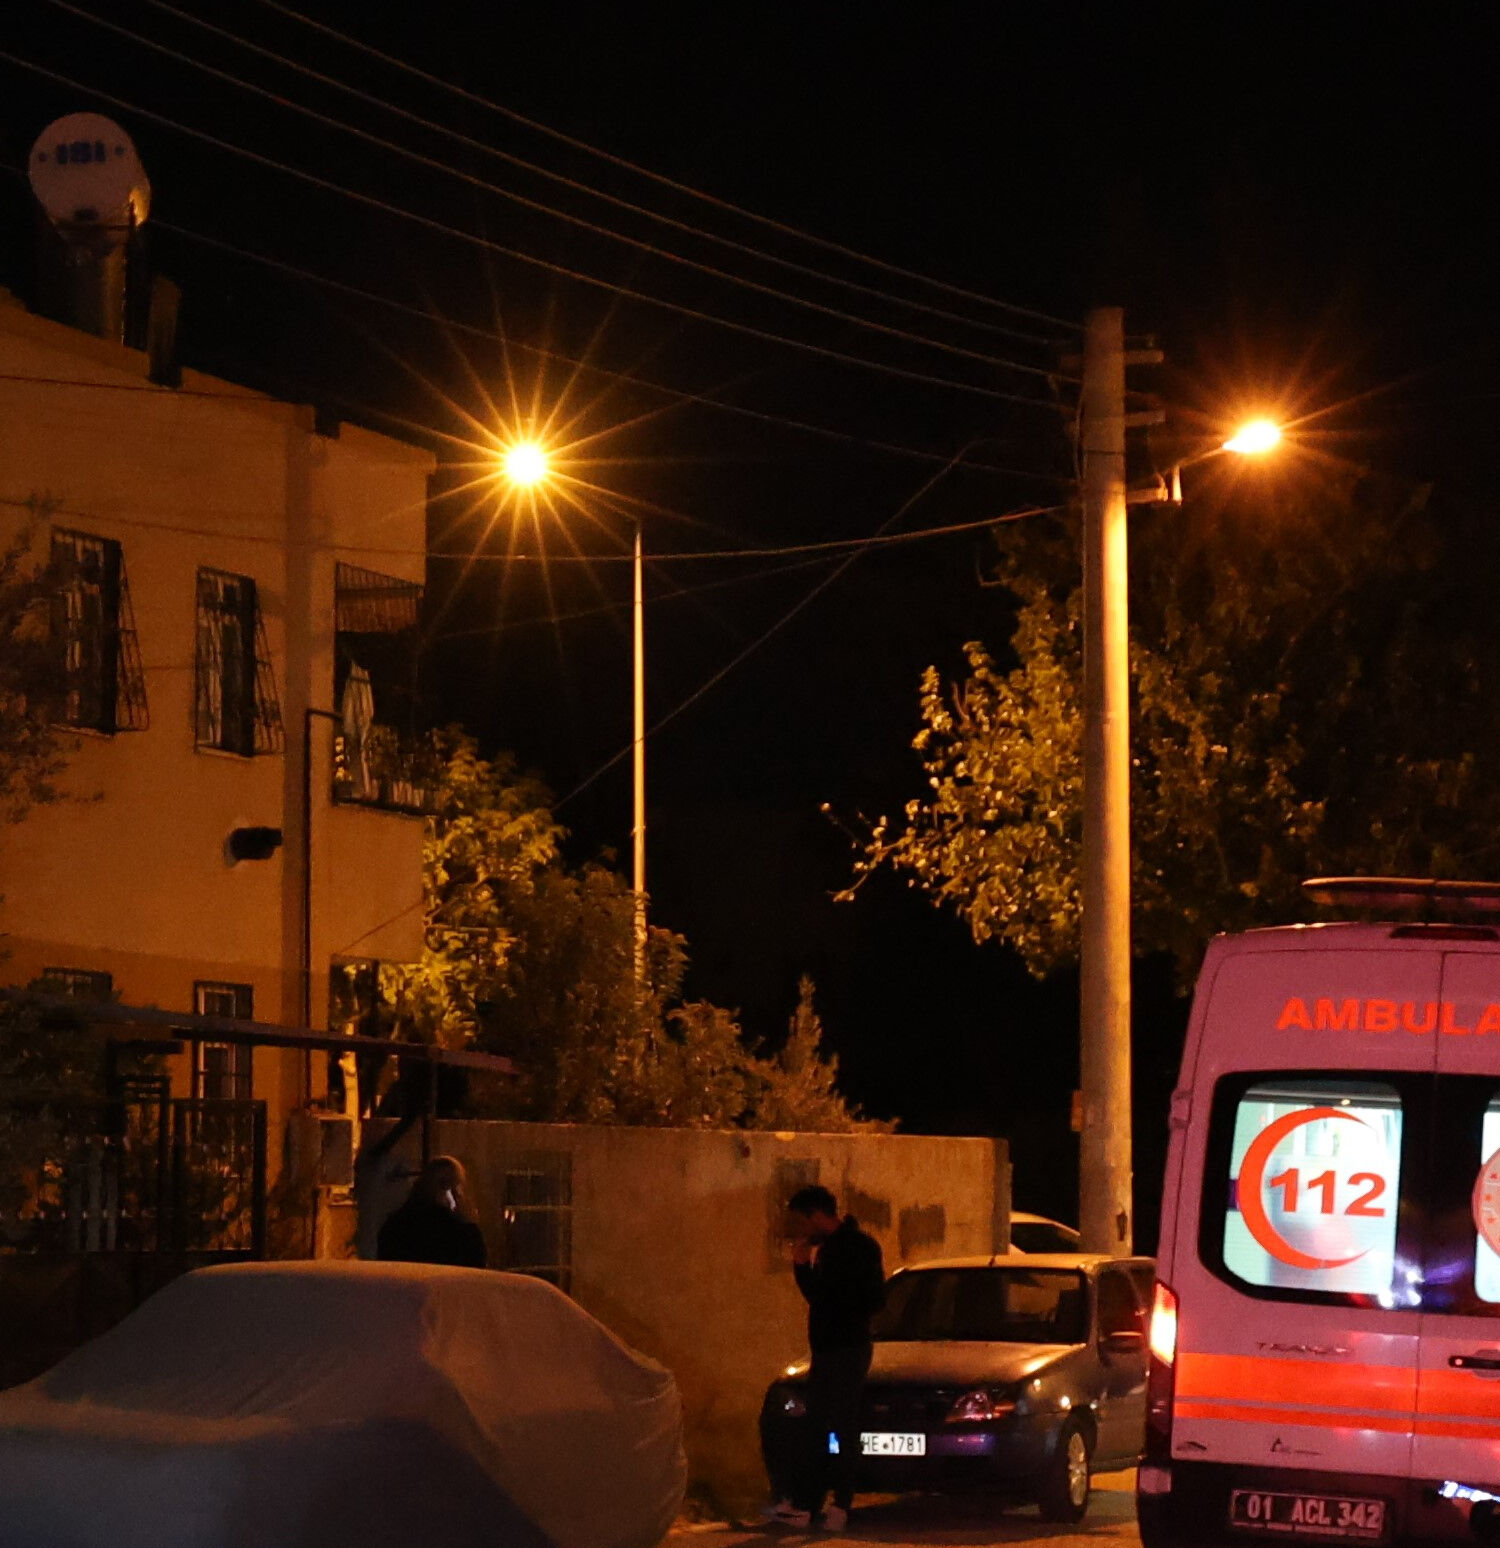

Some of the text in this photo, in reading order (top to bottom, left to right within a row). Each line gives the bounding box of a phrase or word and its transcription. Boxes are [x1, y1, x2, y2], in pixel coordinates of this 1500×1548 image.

[1270, 1167, 1387, 1218] 112
[891, 1436, 923, 1453] 1781
[1247, 1495, 1381, 1529] 01 ACL 342
